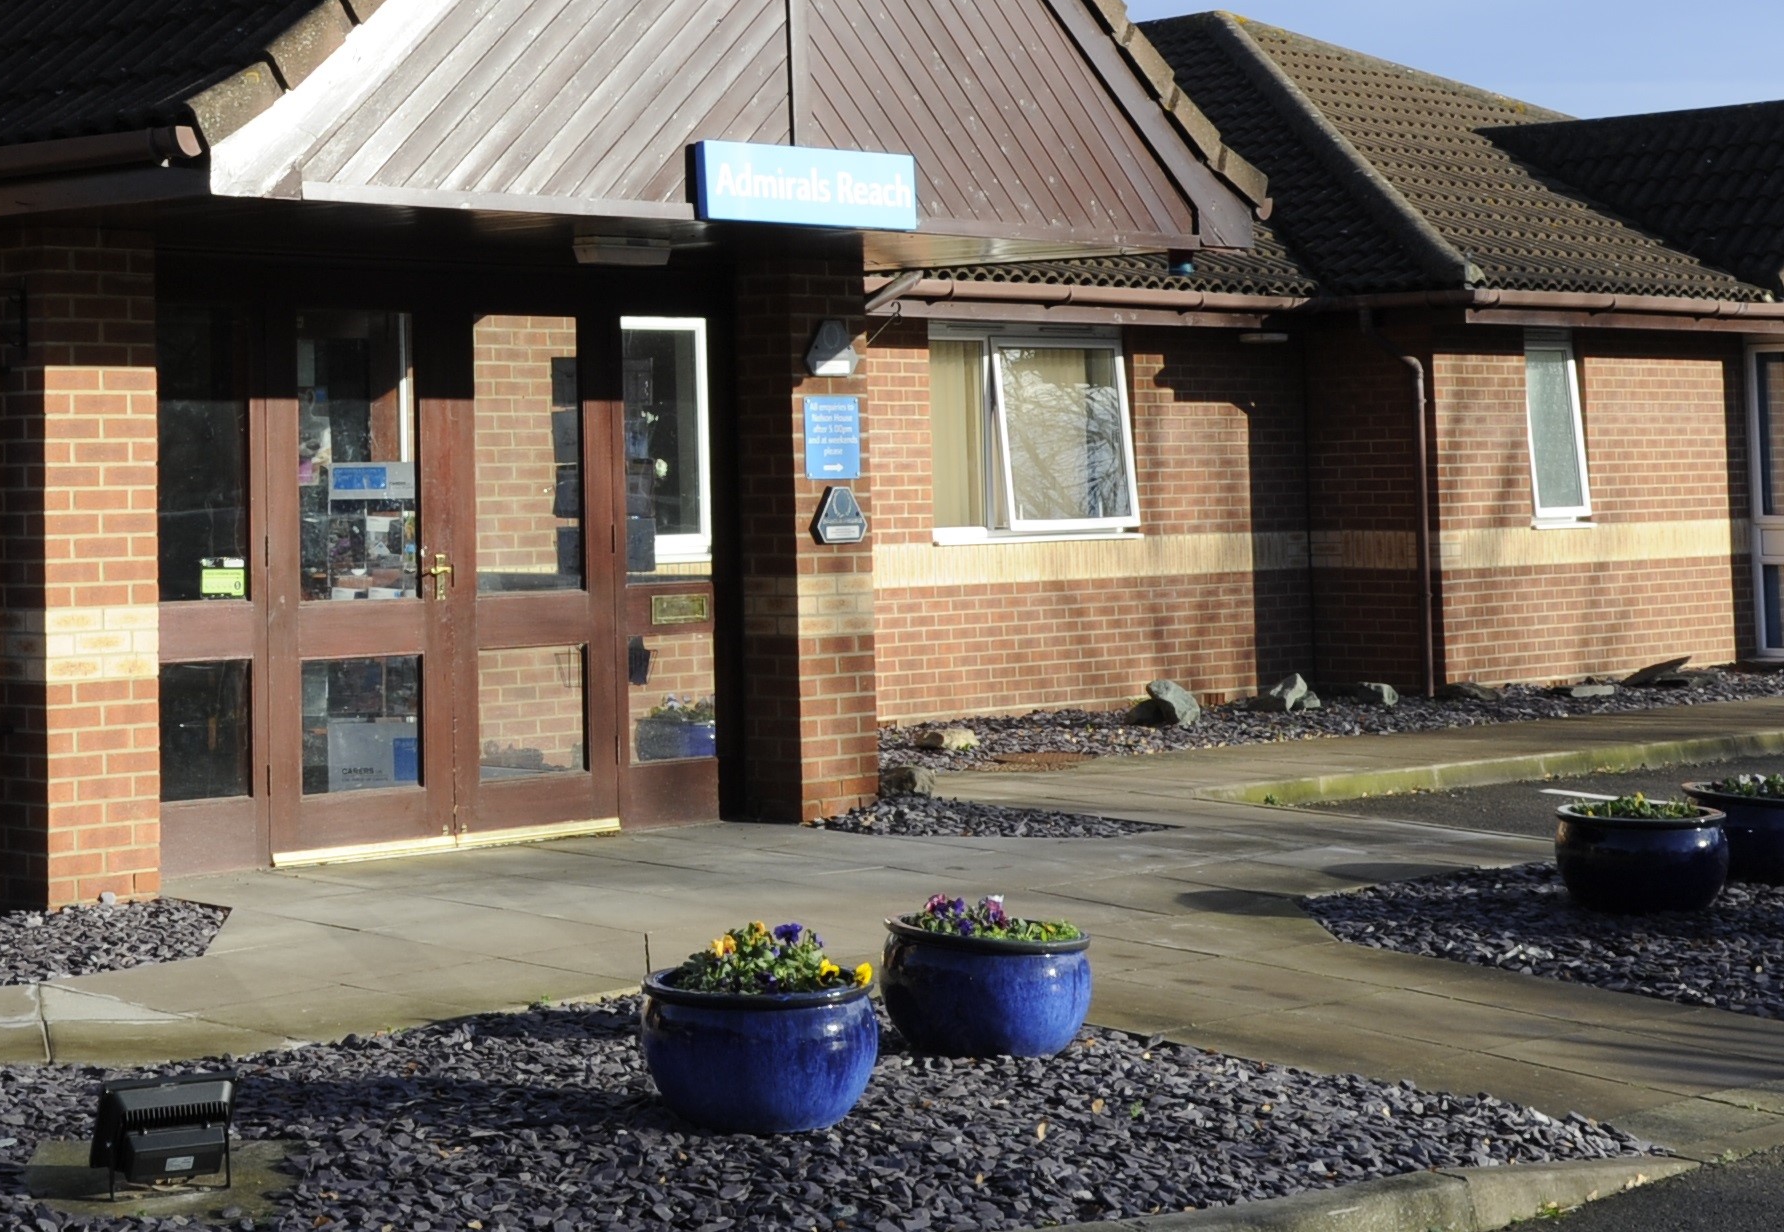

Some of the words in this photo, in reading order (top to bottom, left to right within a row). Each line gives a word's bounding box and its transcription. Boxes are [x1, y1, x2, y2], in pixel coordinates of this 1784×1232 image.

[714, 162, 831, 203] Admirals
[835, 170, 912, 209] Reach
[818, 403, 846, 414] enquiries
[833, 413, 853, 422] House
[808, 435, 820, 444] and
[828, 435, 858, 444] weekends
[823, 446, 843, 457] please
